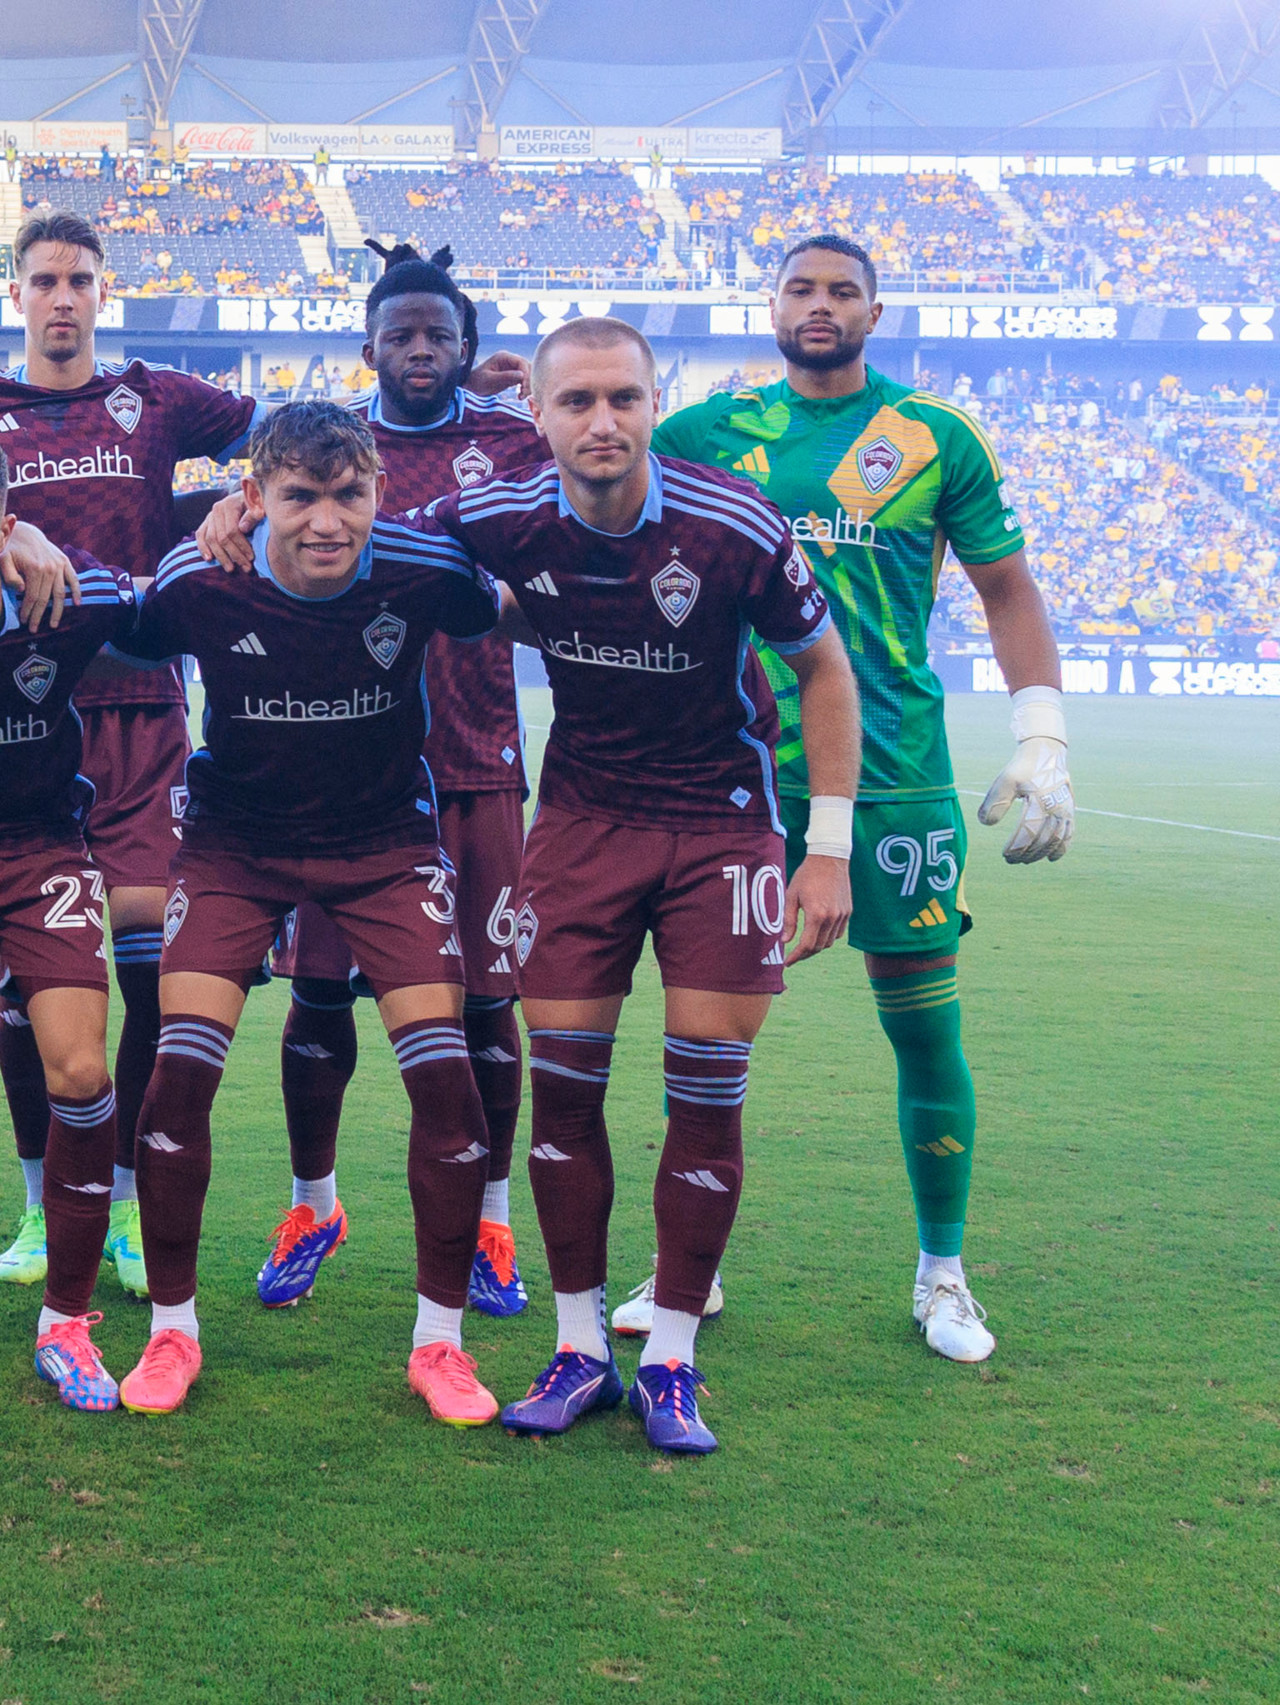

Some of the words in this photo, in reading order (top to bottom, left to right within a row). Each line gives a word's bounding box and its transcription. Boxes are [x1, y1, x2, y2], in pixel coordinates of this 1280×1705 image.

[270, 132, 358, 147] Volkswagen
[361, 134, 379, 145] LA
[394, 134, 450, 145] GALAXY
[504, 129, 591, 141] AMERICAN
[516, 142, 591, 154] EXPRESS
[302, 300, 366, 316] LEAG
[9, 445, 133, 486] uchealth
[543, 631, 691, 672] uchealth
[244, 685, 392, 720] uchealth
[874, 827, 957, 897] 95
[40, 870, 105, 930] 23
[414, 866, 456, 925] 3
[722, 864, 785, 936] 10
[486, 886, 516, 947] 6
